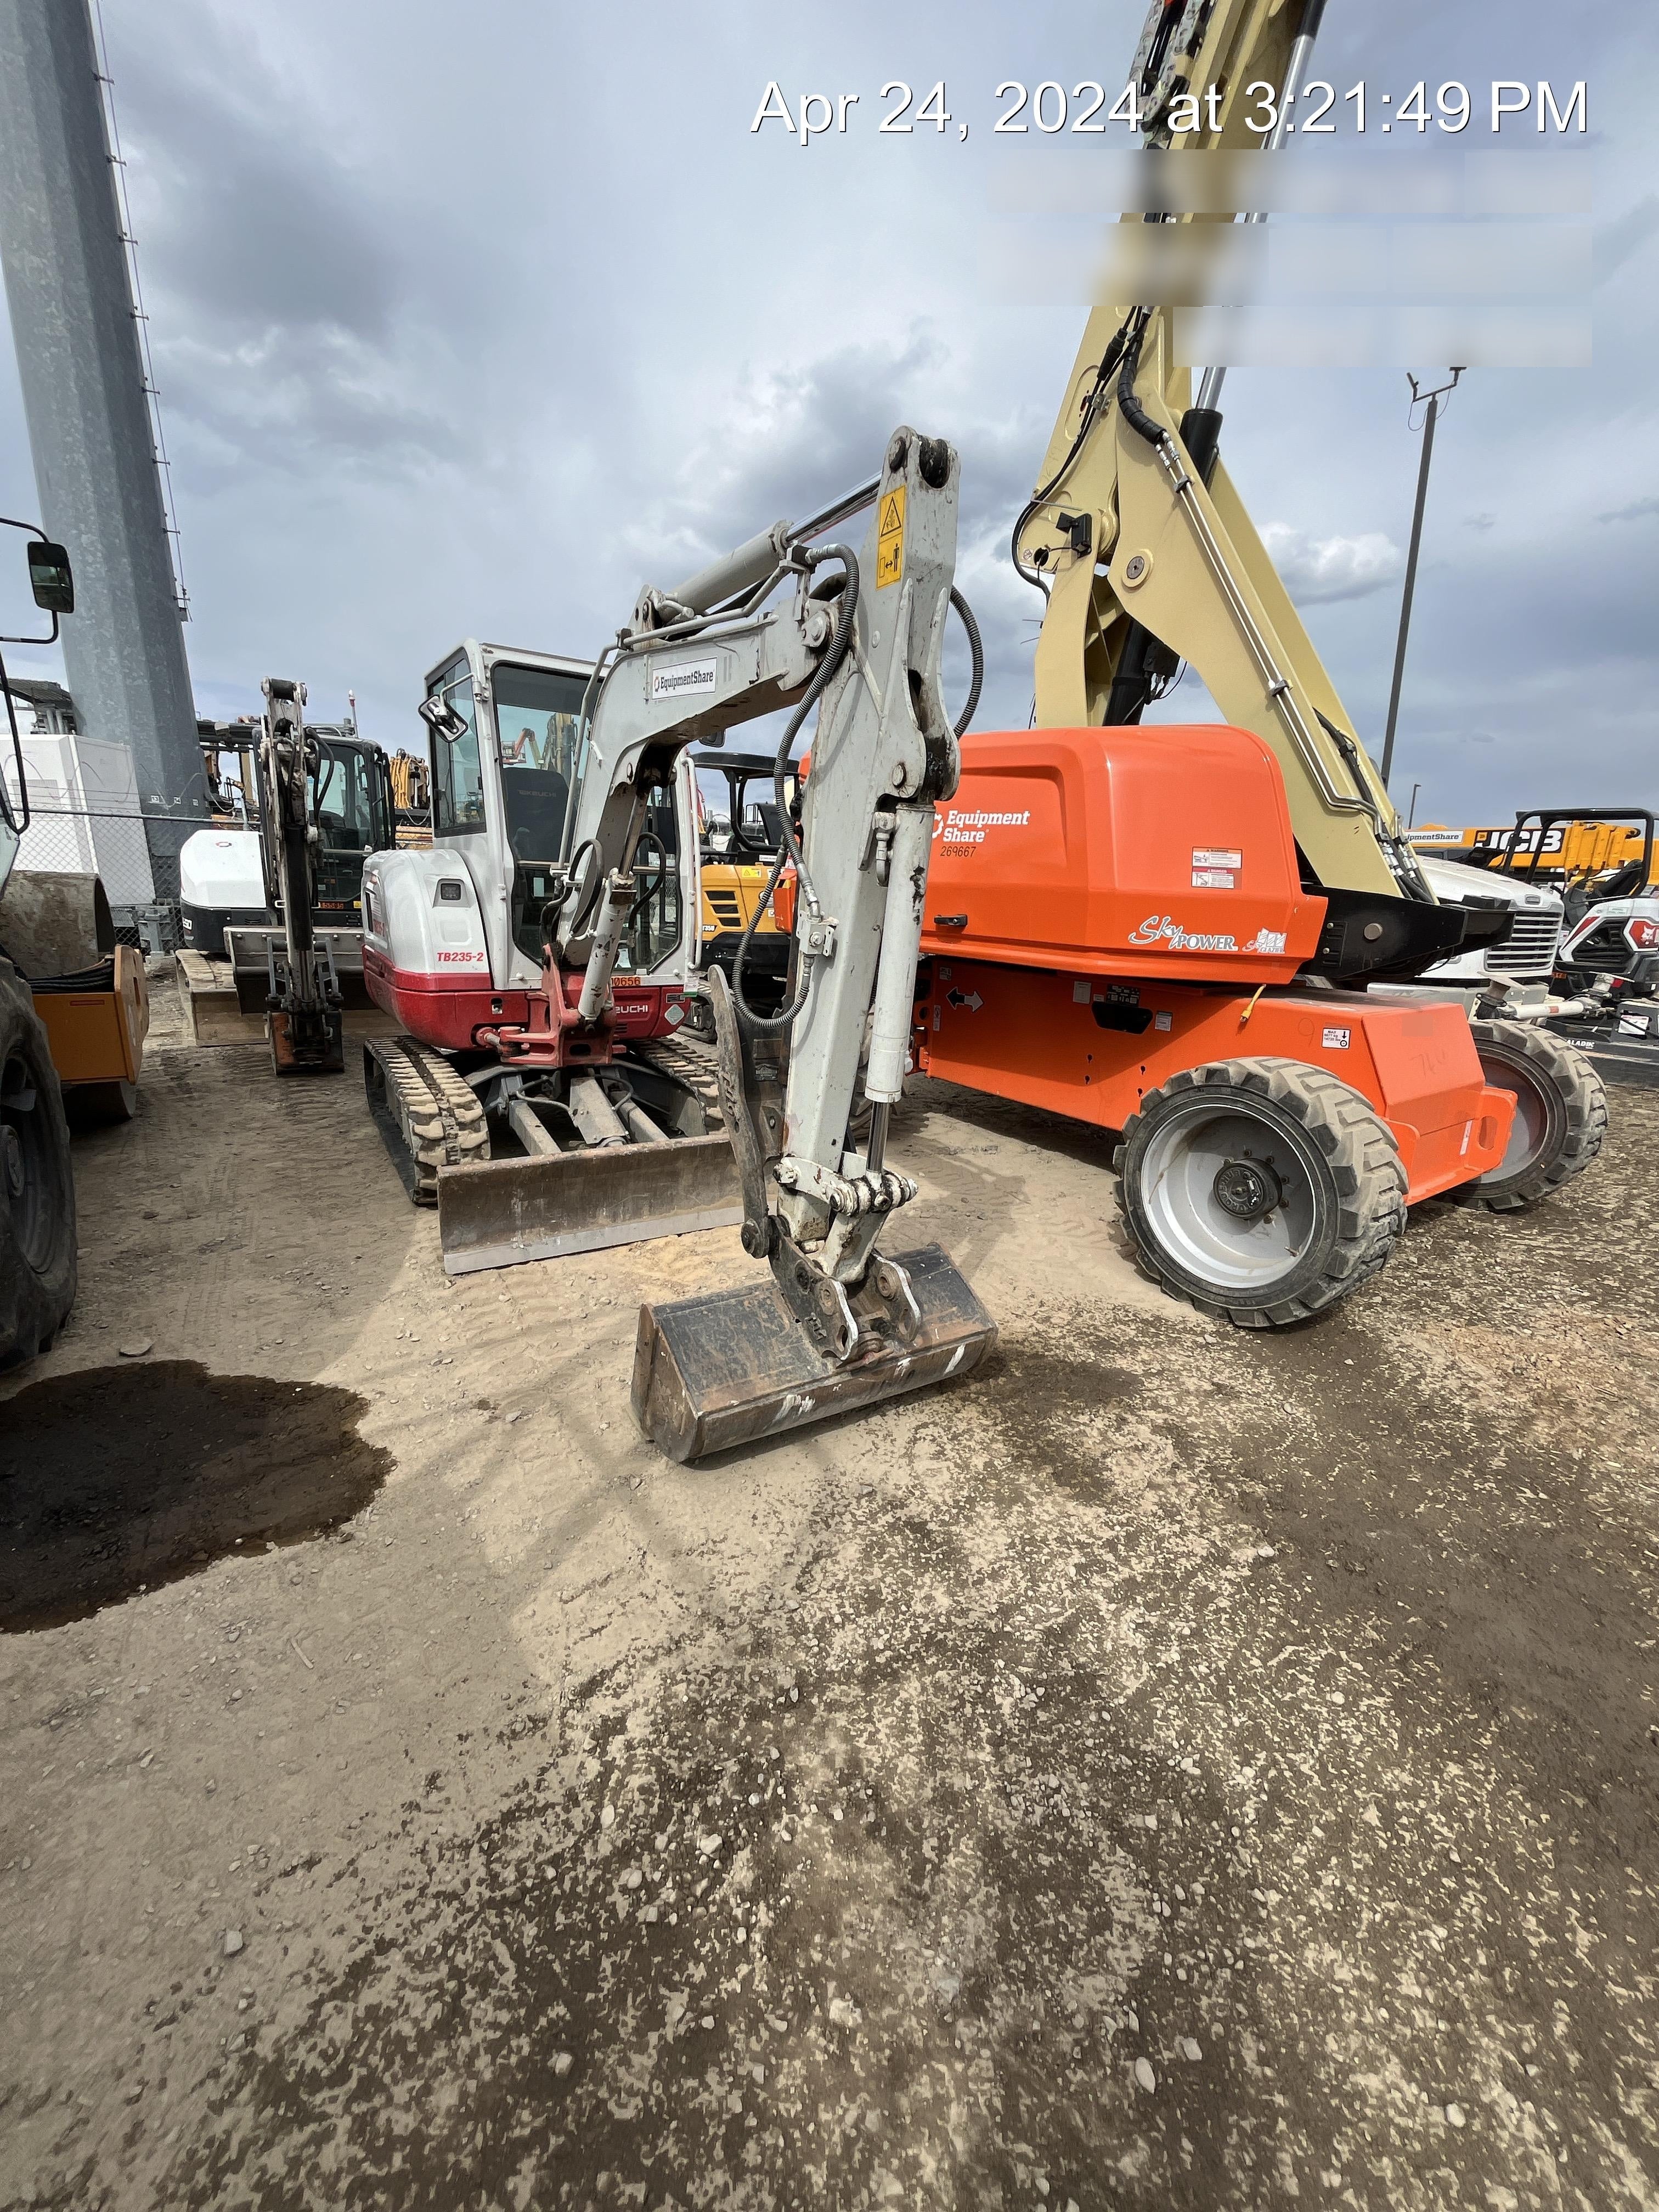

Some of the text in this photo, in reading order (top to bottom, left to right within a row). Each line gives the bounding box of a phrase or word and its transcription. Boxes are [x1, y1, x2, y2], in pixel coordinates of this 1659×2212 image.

[660, 670, 714, 691] EquipmentShare
[946, 810, 1030, 828] Equipment
[943, 827, 985, 842] Share
[1407, 833, 1459, 842] ipmentShare
[1475, 830, 1562, 852] JCB
[940, 845, 977, 857] 269667
[437, 952, 484, 961] TB235-2
[615, 1005, 648, 1013] EUCHI
[1565, 1039, 1595, 1047] ALADIN
